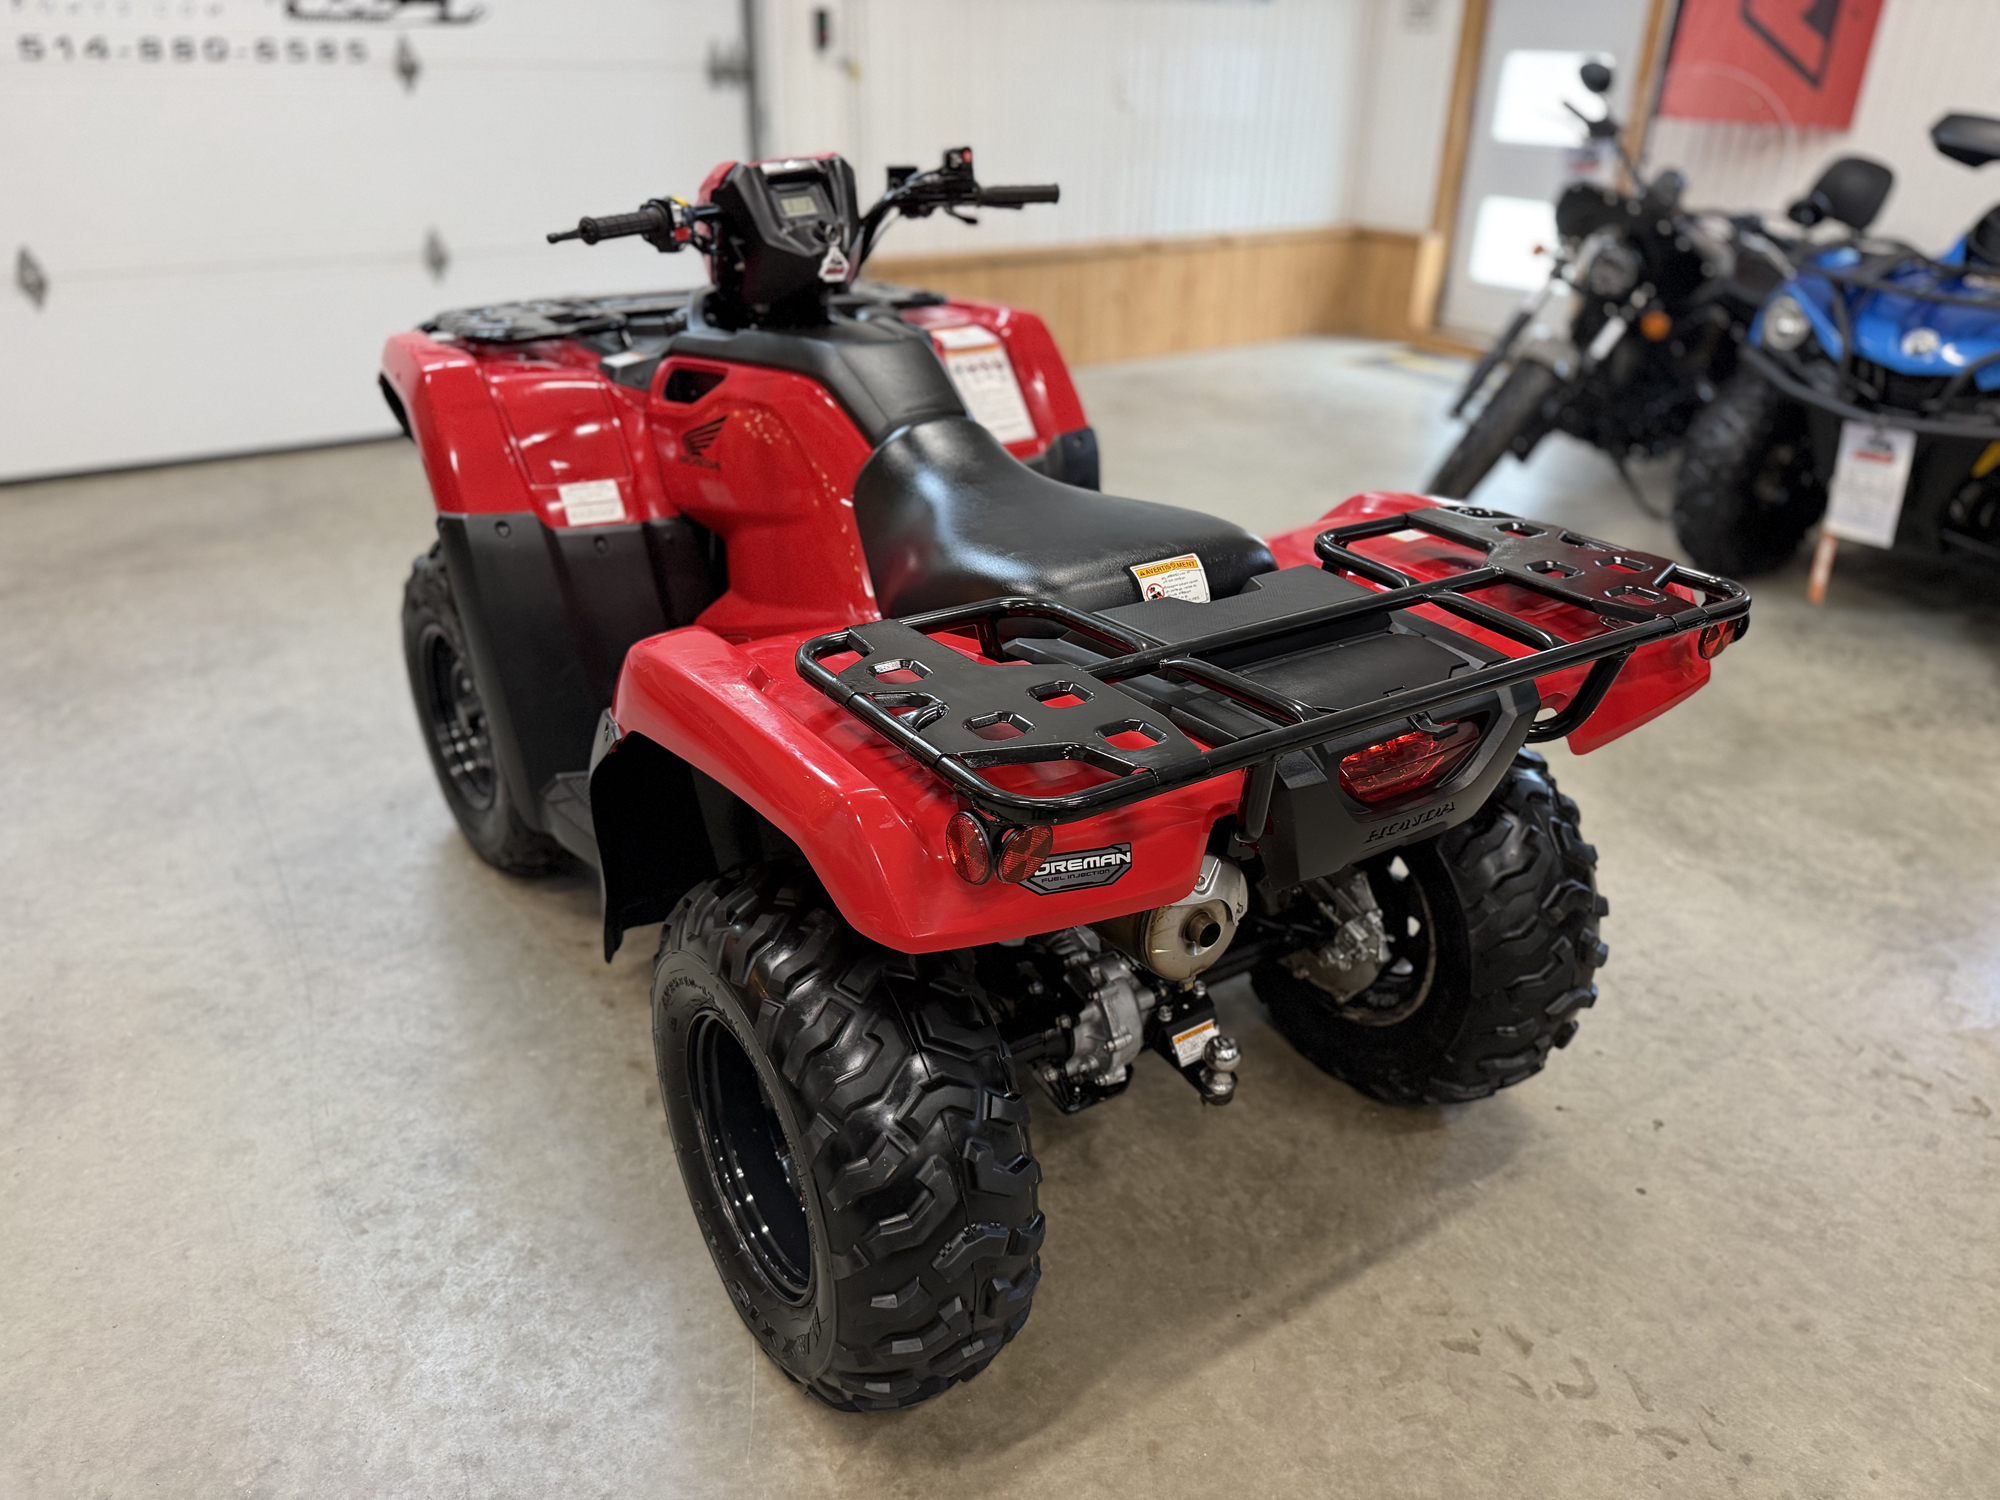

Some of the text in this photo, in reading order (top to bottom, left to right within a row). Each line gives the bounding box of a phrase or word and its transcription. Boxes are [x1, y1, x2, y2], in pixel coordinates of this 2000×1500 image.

[1363, 802, 1456, 844] HONDA
[1034, 852, 1131, 876] OREMAN
[1041, 869, 1110, 883] FUEL INJECTION
